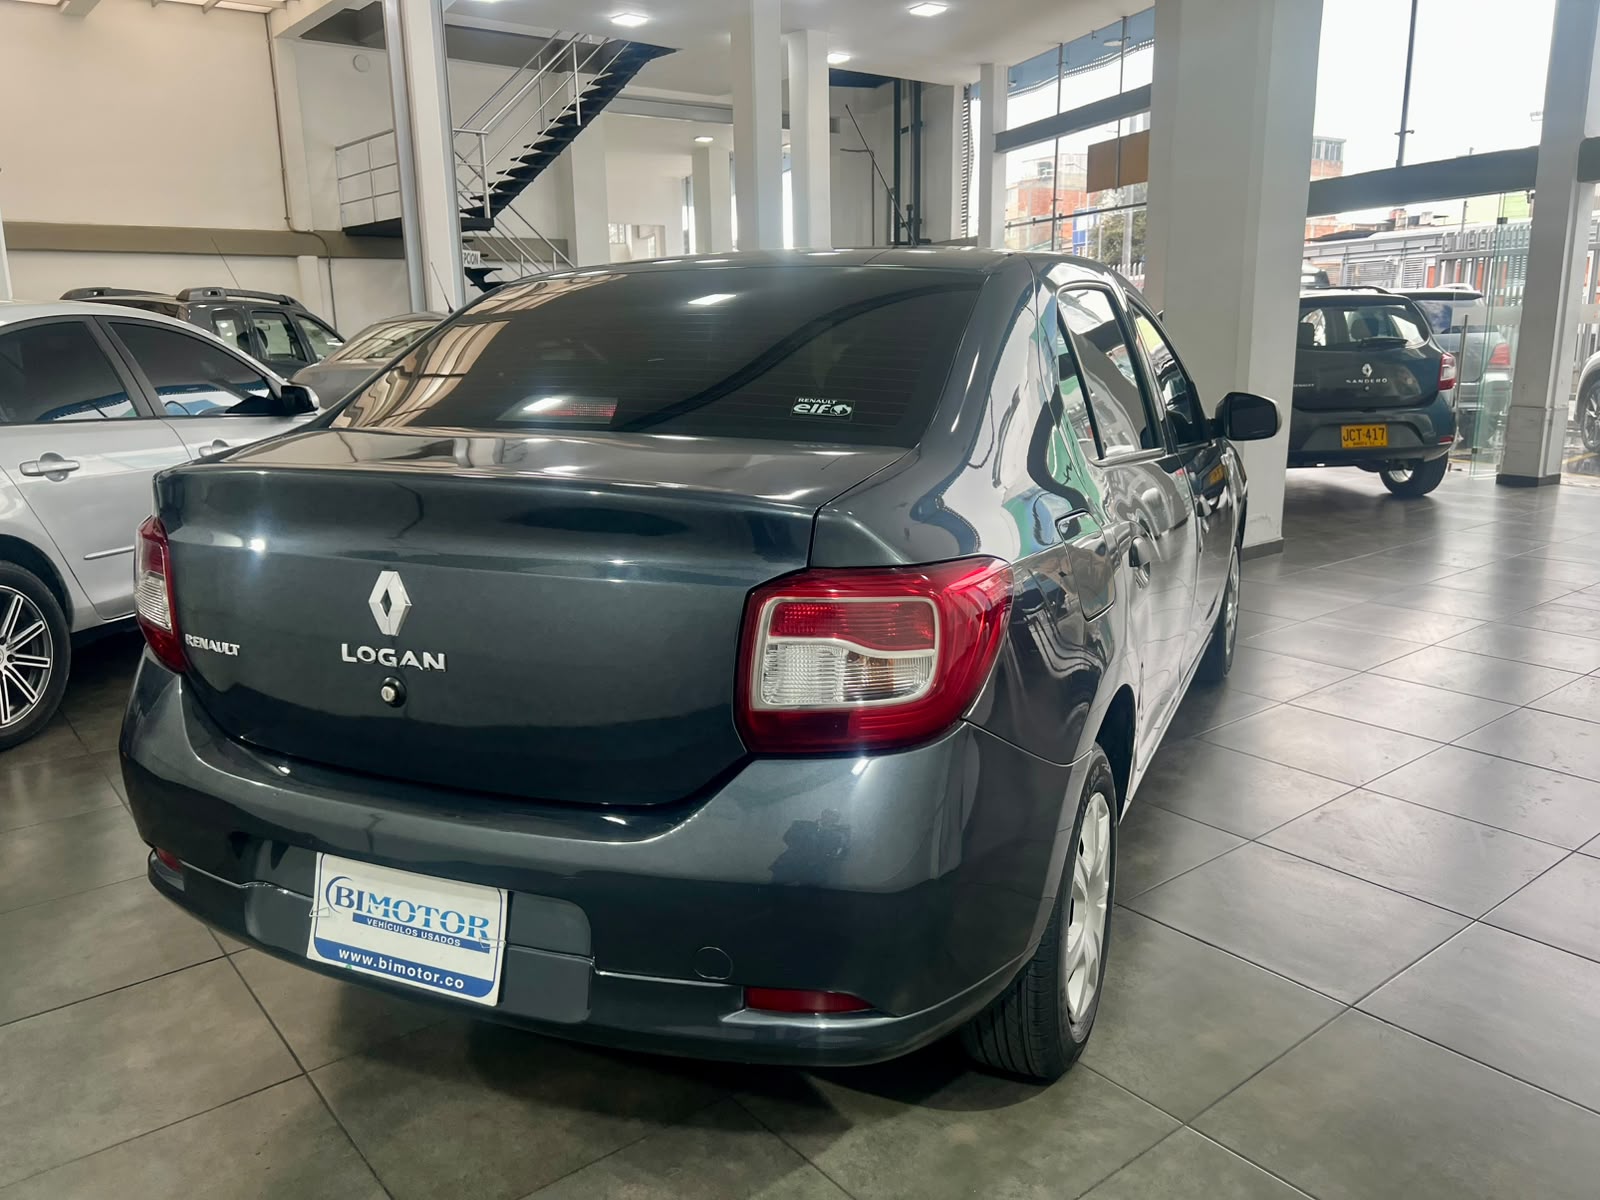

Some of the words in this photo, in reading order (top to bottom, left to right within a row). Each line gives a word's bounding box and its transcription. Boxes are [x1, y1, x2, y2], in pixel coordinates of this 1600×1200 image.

[793, 403, 832, 414] elf
[797, 397, 837, 405] RENAULT
[184, 632, 241, 657] RENAULT
[340, 642, 448, 673] LOGAN
[334, 885, 491, 941] BIMOTOR
[420, 930, 462, 948] USADOS
[338, 948, 465, 990] www.bimotor.co
